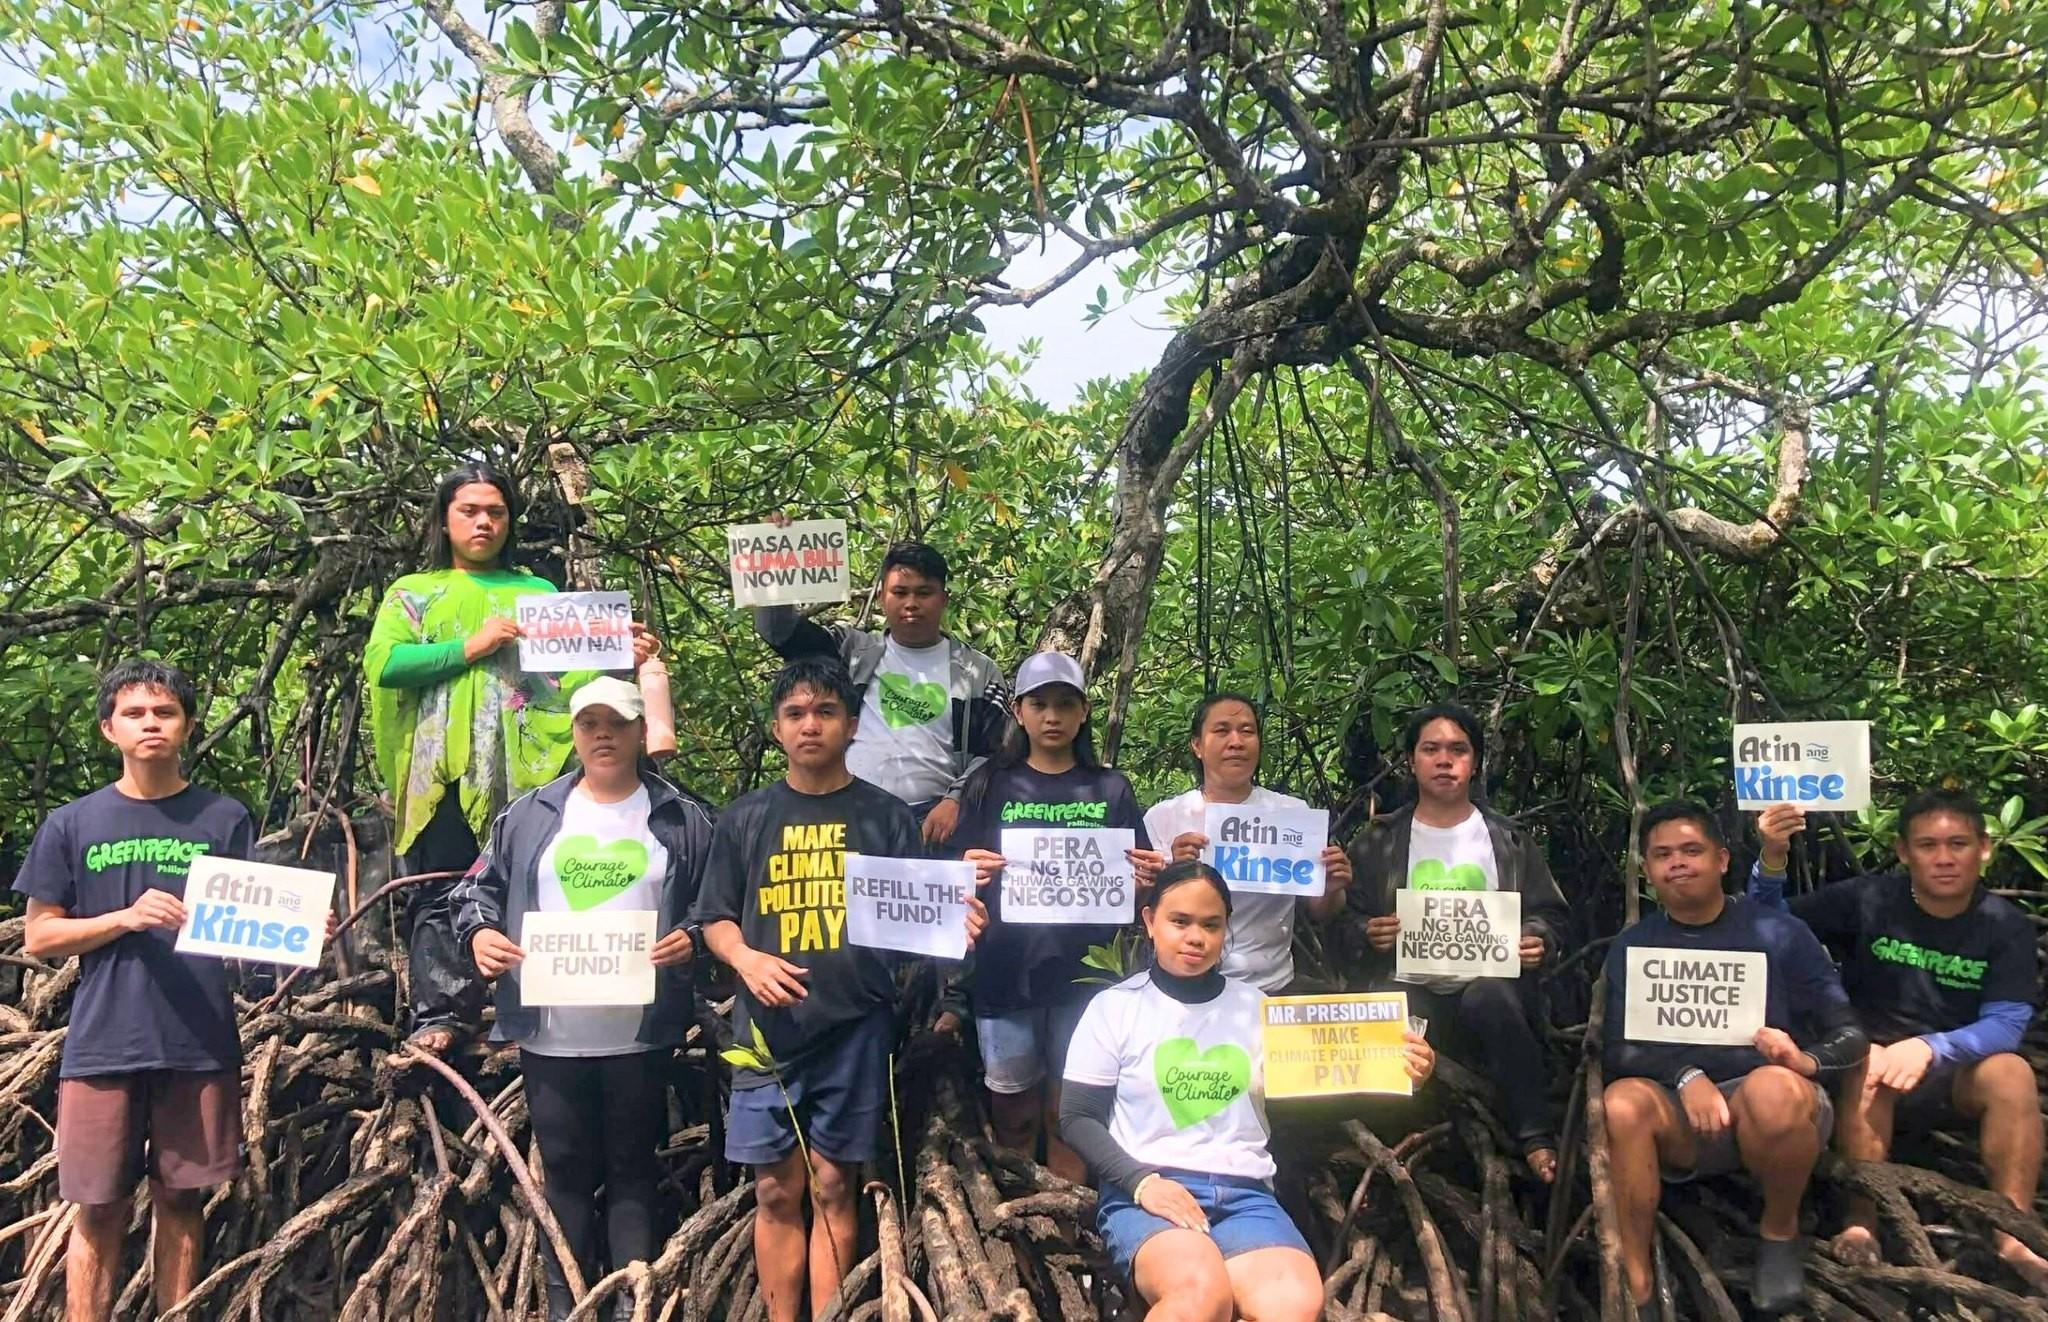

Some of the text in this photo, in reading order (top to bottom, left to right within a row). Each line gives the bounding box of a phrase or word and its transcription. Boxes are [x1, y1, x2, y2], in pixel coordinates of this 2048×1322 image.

[732, 532, 844, 554] IPASA ANG
[736, 549, 844, 572] CLIMA BILL
[744, 566, 838, 588] NOW NA!
[520, 604, 628, 622] IPASA ANG
[531, 635, 622, 654] NOW NA!
[1739, 734, 1829, 762] Atin ang
[1735, 765, 1844, 801] Kinse
[1001, 801, 1108, 822] GREENPEACE
[783, 824, 846, 850] MAKE
[1221, 817, 1302, 844] Atin ang
[1034, 837, 1102, 860] PERA
[157, 864, 190, 875] Philipp
[564, 858, 628, 880] Courage
[770, 852, 859, 882] CLIMAT
[1031, 860, 1105, 876] NG TAO
[1214, 846, 1314, 884] Kinse
[206, 872, 272, 906] Atin
[573, 872, 631, 888] Climate
[852, 877, 966, 904] REFILL THE
[1011, 876, 1124, 888] HUWAG GAWING
[760, 880, 846, 914] POLLUTE
[1008, 887, 1125, 907] NEGOSYO
[1424, 897, 1488, 918] PERA
[876, 902, 942, 925] FUND!
[190, 902, 309, 952] Kinse
[780, 909, 846, 954] PAY
[1422, 918, 1491, 934] NG TAO
[530, 932, 646, 952] REFILL THE
[1404, 931, 1508, 945] HUWAG GAWING
[1402, 942, 1509, 962] NEGOSYO
[1871, 936, 1988, 980] GREENPEACE
[552, 956, 620, 976] FUND!
[1643, 960, 1746, 982] CLIMATE
[1646, 983, 1740, 1006] JUSTICE
[1268, 1002, 1400, 1024] MR. PRESIDENT
[1657, 1006, 1728, 1030] NOW!
[1312, 1027, 1360, 1044] MAKE
[1270, 1050, 1328, 1064] CLIMATE
[1166, 1066, 1232, 1090] Courage
[1314, 1064, 1360, 1087] PAY
[1176, 1082, 1234, 1100] Climate
